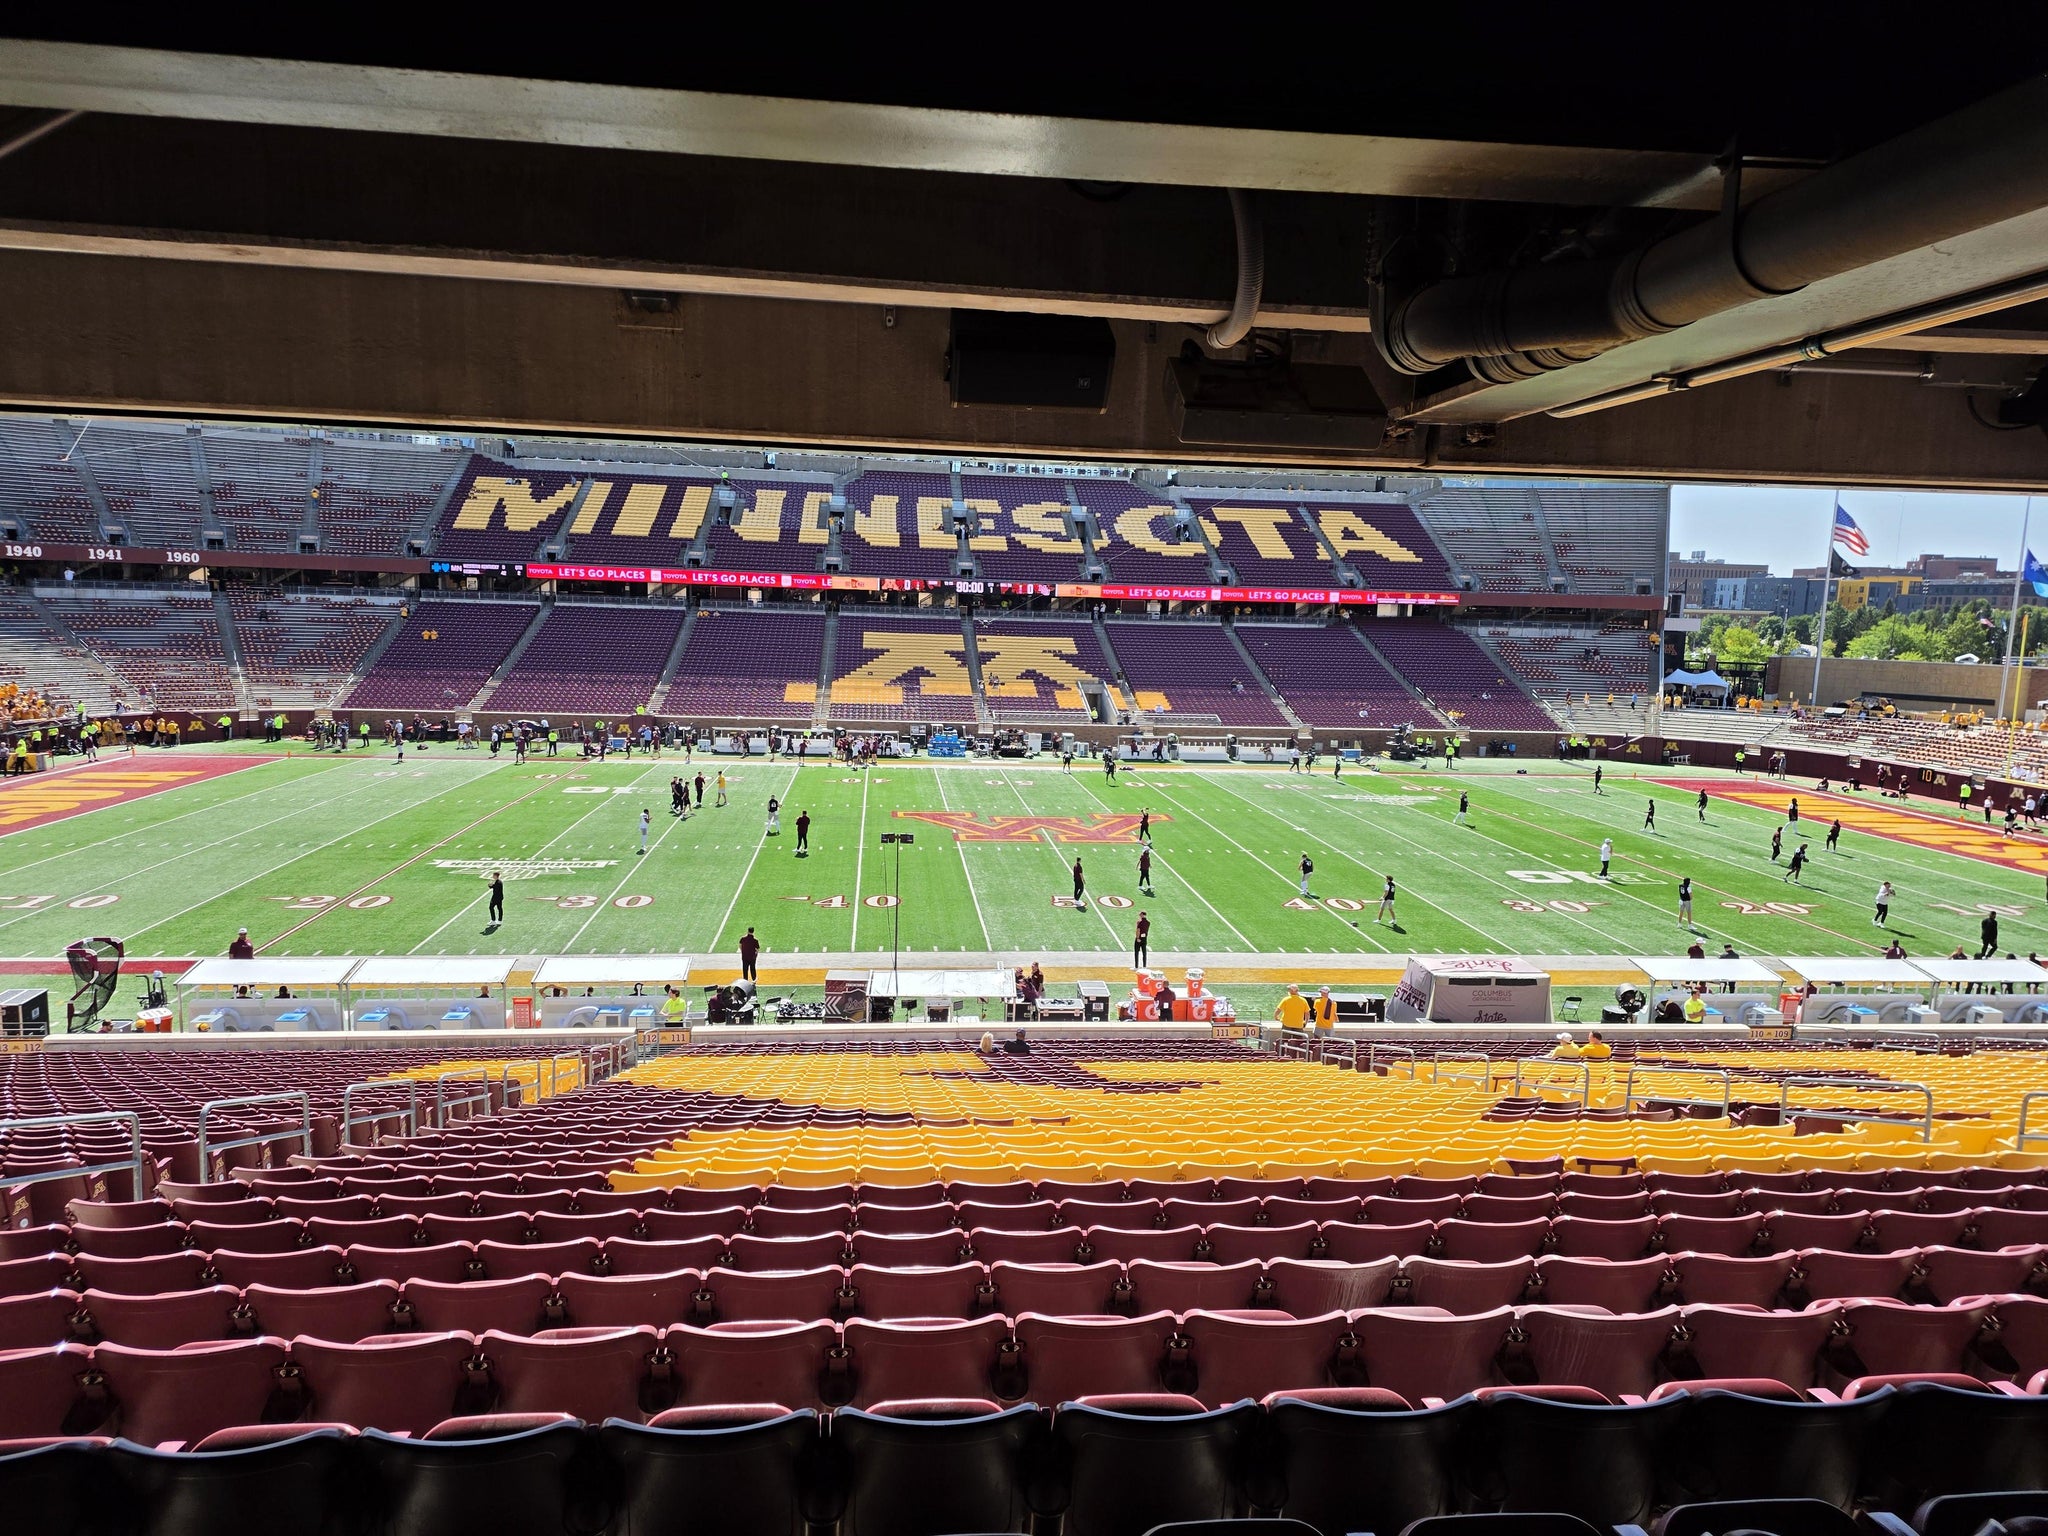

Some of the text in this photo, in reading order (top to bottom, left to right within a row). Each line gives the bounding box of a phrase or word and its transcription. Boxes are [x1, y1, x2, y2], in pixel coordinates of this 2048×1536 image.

[453, 476, 1423, 563] MINNESOTA
[5, 545, 42, 558] 1940
[88, 548, 122, 561] 1941
[166, 551, 200, 563] 1960
[558, 568, 645, 580] LET'S GO PLACES
[692, 572, 776, 585] LET'S GO PLACES
[956, 581, 984, 593] 90:00
[1102, 588, 1124, 596] TOYOTA
[1128, 588, 1206, 599] LET'S GO PLACES
[1248, 591, 1325, 602] LET'S GO PLACES
[1920, 769, 1933, 782] 10
[1393, 987, 1426, 1013] STATE
[1474, 1009, 1507, 1023] State
[671, 1034, 686, 1042] 111
[24, 1043, 41, 1051] 112
